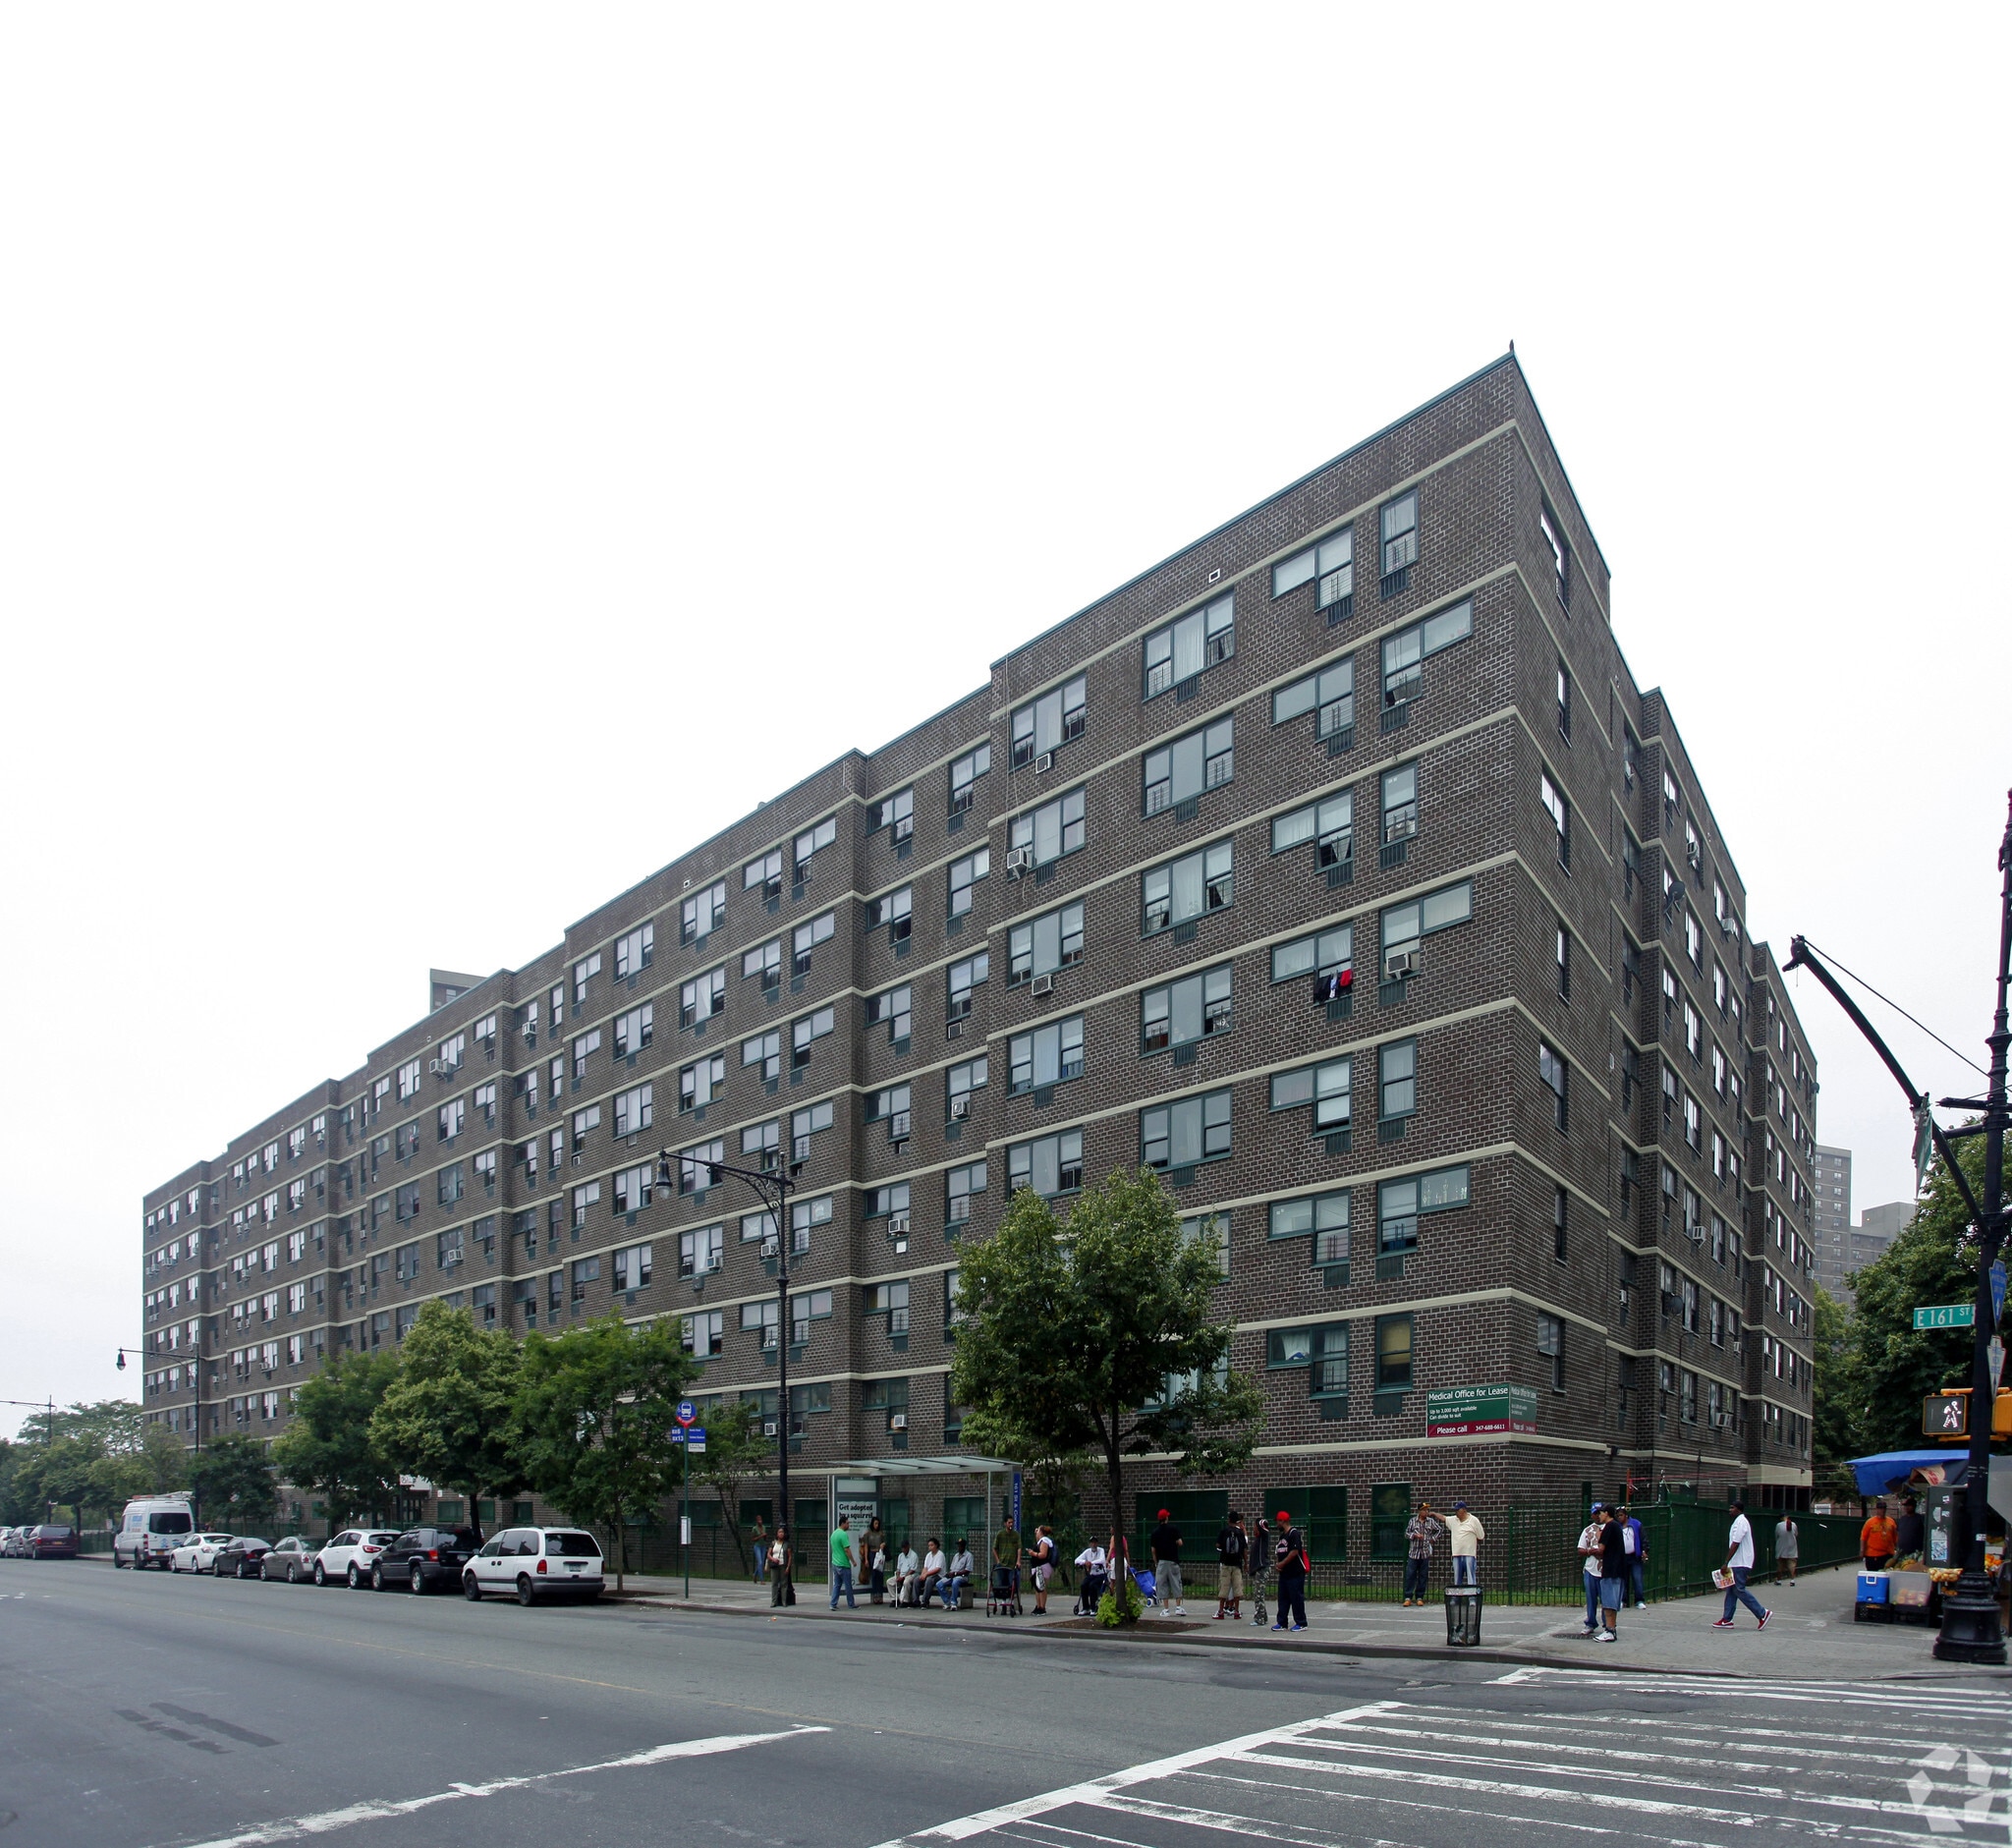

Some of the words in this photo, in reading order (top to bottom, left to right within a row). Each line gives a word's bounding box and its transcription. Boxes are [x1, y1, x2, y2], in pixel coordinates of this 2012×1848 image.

[1917, 1311, 1925, 1326] E
[1930, 1308, 1954, 1325] 161
[1959, 1307, 1971, 1316] ST
[1428, 1390, 1453, 1401] Medical
[1454, 1389, 1475, 1399] Office
[1476, 1387, 1486, 1397] for
[1487, 1386, 1508, 1396] Lease
[1436, 1426, 1456, 1434] Please
[850, 1503, 873, 1512] adopted
